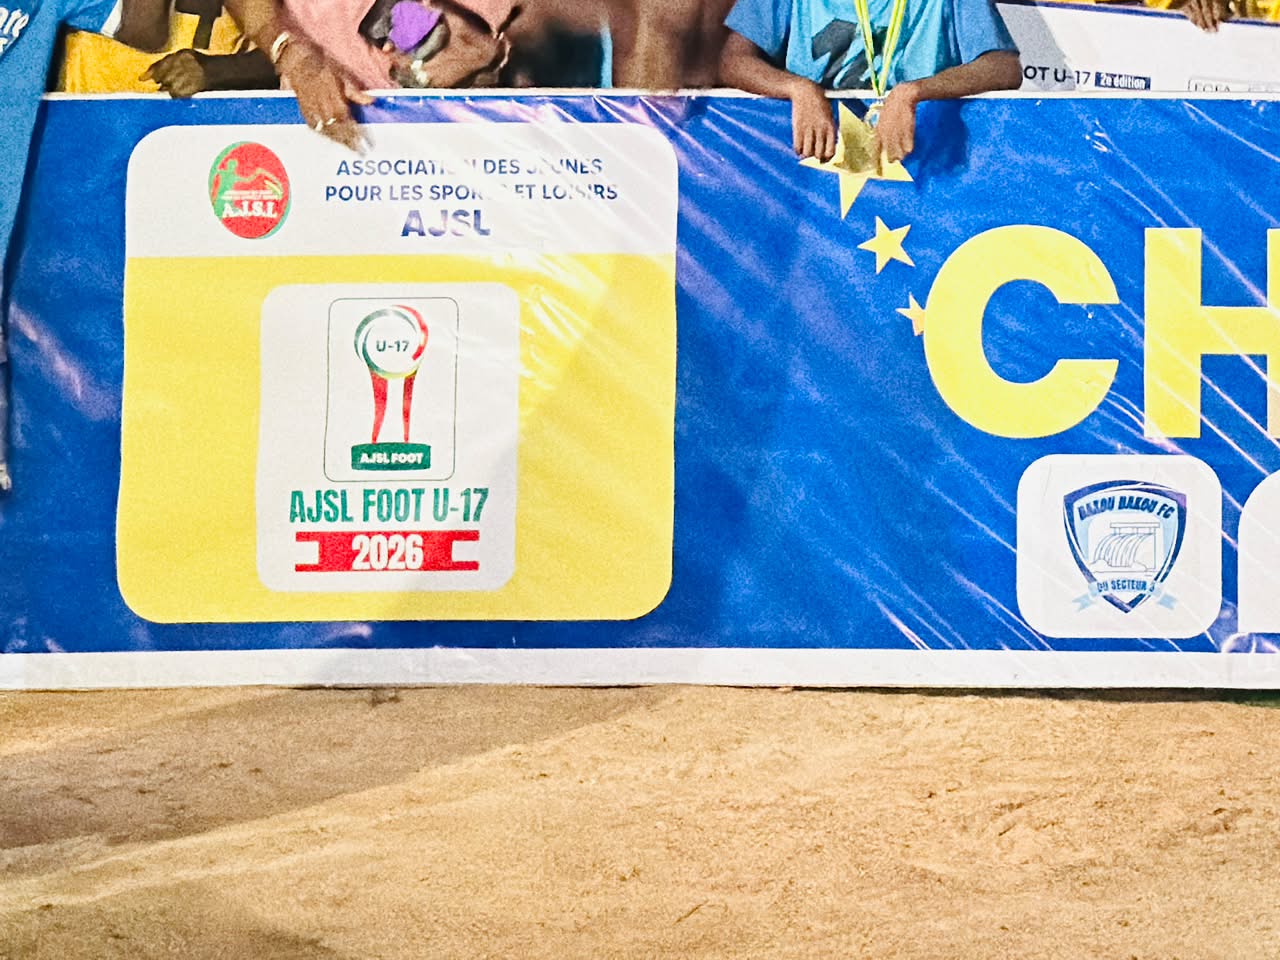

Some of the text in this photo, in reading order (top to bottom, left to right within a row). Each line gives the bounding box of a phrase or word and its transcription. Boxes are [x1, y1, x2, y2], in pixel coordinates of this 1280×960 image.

[1023, 65, 1050, 81] OT
[1053, 67, 1091, 85] U-17
[336, 158, 603, 176] ASSOCIATI DES NES
[325, 185, 382, 201] POUR
[389, 185, 423, 201] LES
[429, 184, 506, 201] SPOR
[542, 184, 618, 200] LORS
[400, 209, 491, 237] AJSL
[375, 339, 410, 353] U-17
[360, 451, 424, 465] AJSL FOOT
[289, 487, 490, 523] AJSL FOOT U-17
[1156, 503, 1176, 519] FC
[351, 533, 424, 571] 2026
